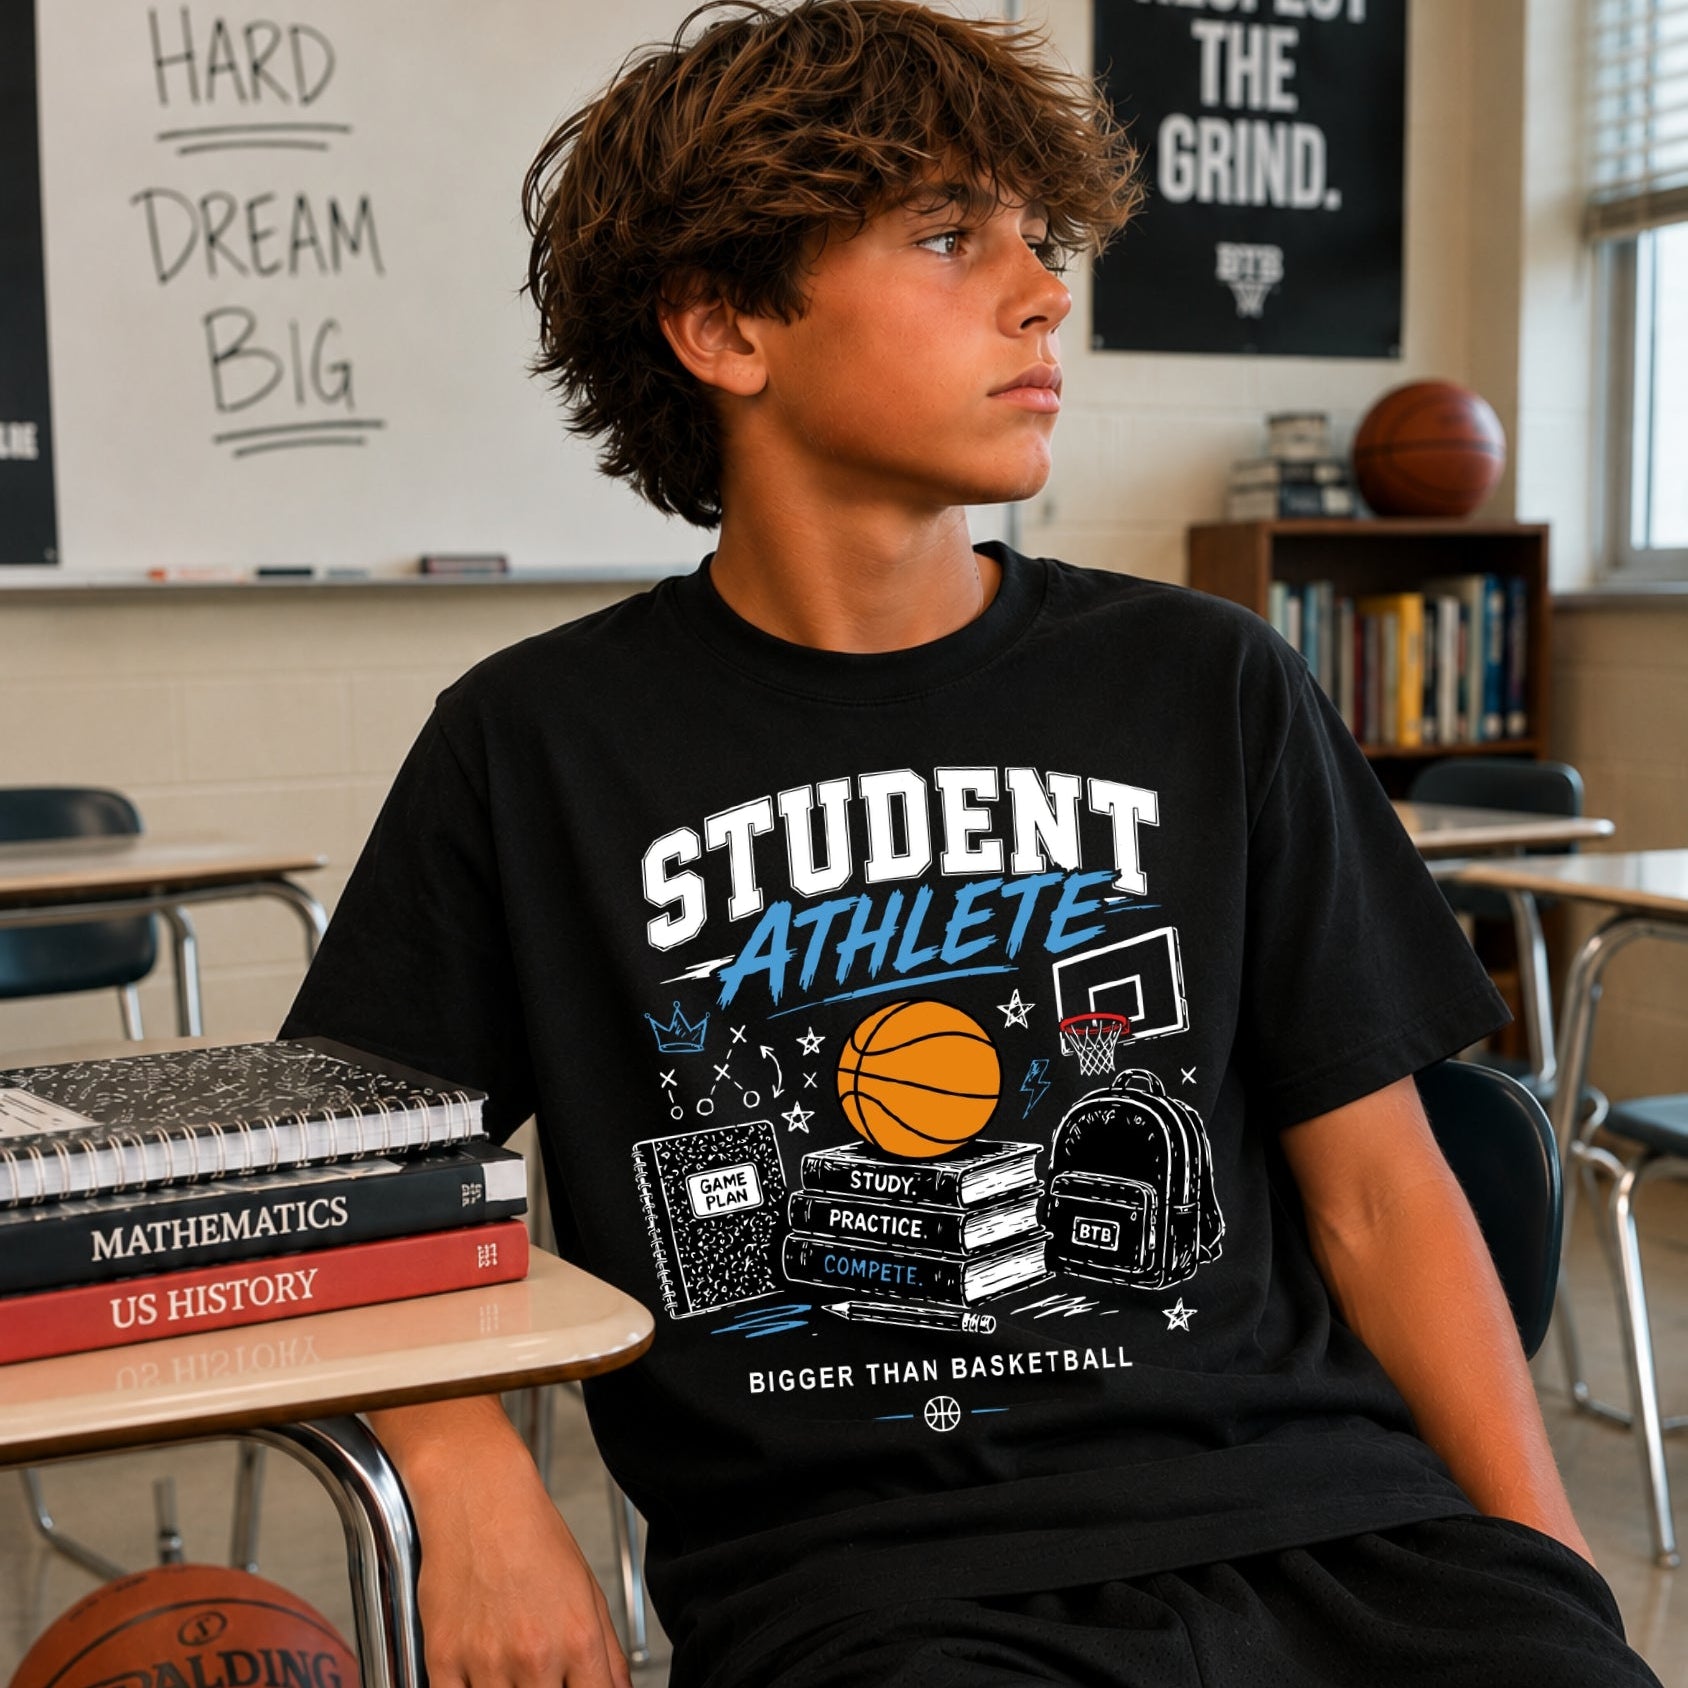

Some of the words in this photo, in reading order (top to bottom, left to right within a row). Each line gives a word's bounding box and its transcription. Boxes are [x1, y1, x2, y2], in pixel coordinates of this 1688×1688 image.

[149, 8, 335, 107] HARD
[1190, 18, 1300, 113] THE
[1157, 112, 1343, 211] GRIND.
[131, 188, 384, 284] DREAM
[204, 307, 356, 413] BIG
[641, 766, 1159, 952] STUDENT
[716, 868, 1122, 1008] ATHLETE
[699, 1170, 748, 1195] GAME
[705, 1188, 749, 1212] PLAN
[850, 1169, 917, 1196] STUDY.
[90, 1196, 349, 1263] MATHEMATICS
[828, 1208, 928, 1240] PRACTICE.
[1078, 1222, 1113, 1245] BTB
[110, 1293, 158, 1329] US
[166, 1267, 319, 1322] HISTORY
[823, 1254, 924, 1287] COMPETE.
[749, 1365, 855, 1394] BIGGER
[865, 1359, 939, 1385] THAN
[951, 1345, 1133, 1380] BASKETBALL
